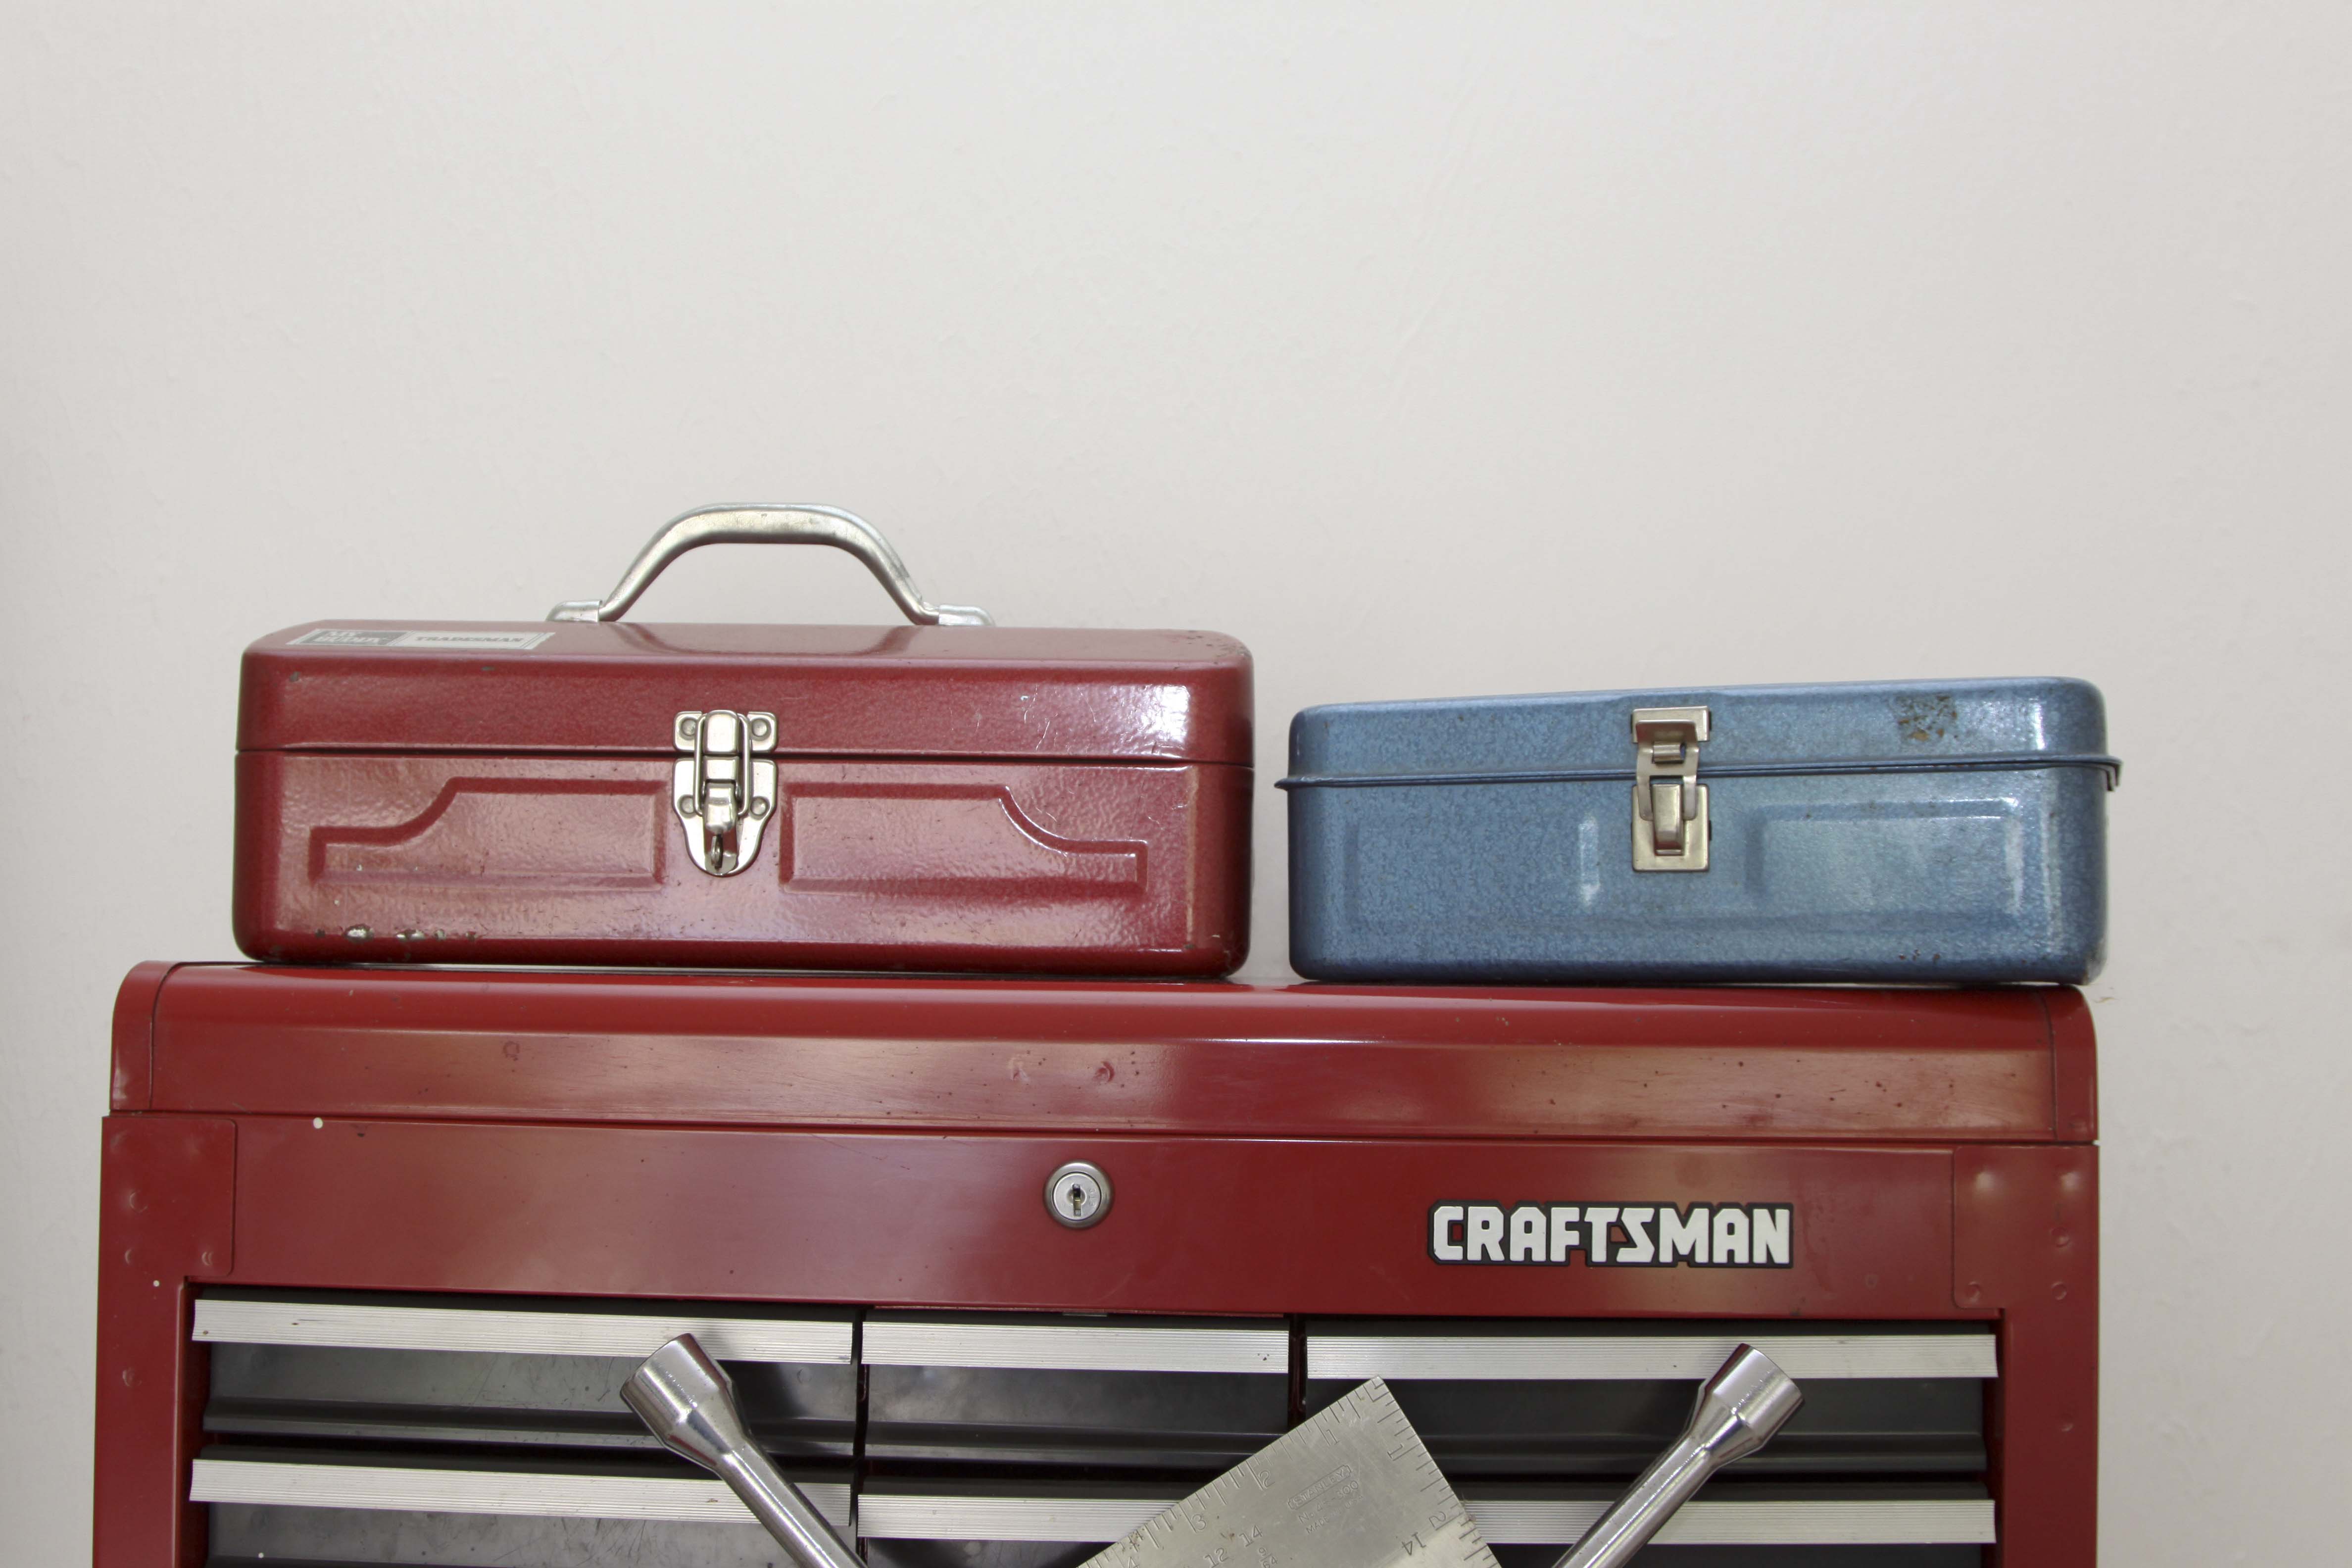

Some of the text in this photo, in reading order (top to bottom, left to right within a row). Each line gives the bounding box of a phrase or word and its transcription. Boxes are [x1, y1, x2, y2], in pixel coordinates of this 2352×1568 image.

[1433, 1206, 1790, 1264] CRAFTSMAN
[1326, 1428, 1340, 1445] 1
[1387, 1444, 1403, 1459] 1
[1259, 1470, 1275, 1489] 2
[1293, 1469, 1344, 1505] STANLEY
[1191, 1514, 1207, 1530] 3
[1306, 1516, 1330, 1534] MADE
[1428, 1511, 1447, 1528] 2
[1239, 1524, 1263, 1547] 14
[1401, 1532, 1426, 1556] 14
[1204, 1547, 1229, 1568] 12
